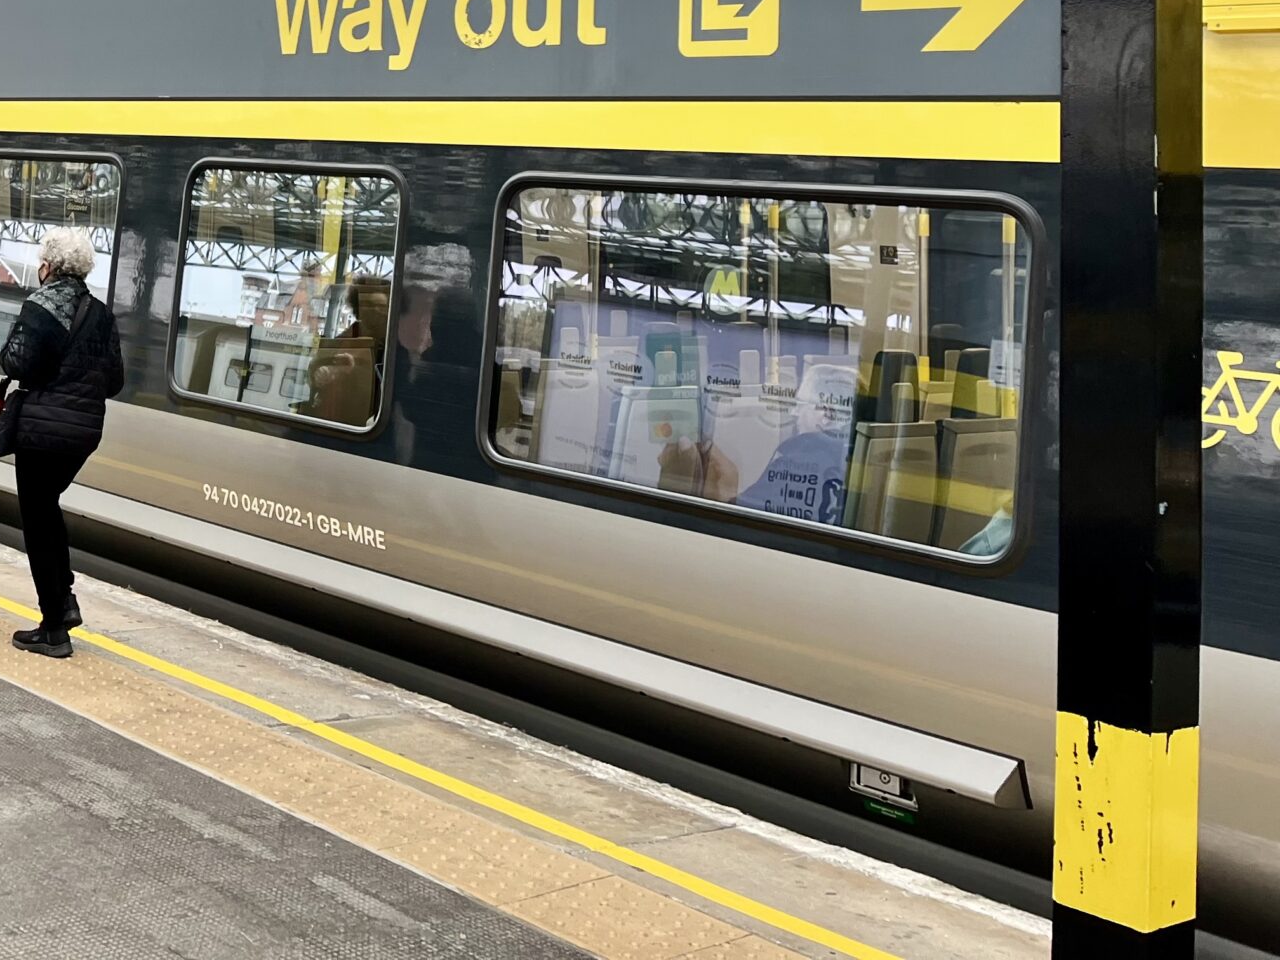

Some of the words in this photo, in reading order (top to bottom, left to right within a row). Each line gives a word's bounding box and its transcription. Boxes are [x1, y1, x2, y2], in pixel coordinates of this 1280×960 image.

[203, 483, 220, 503] 94
[220, 488, 239, 509] 70
[241, 494, 314, 530] 0427022-1
[316, 514, 387, 550] GB-MRE
